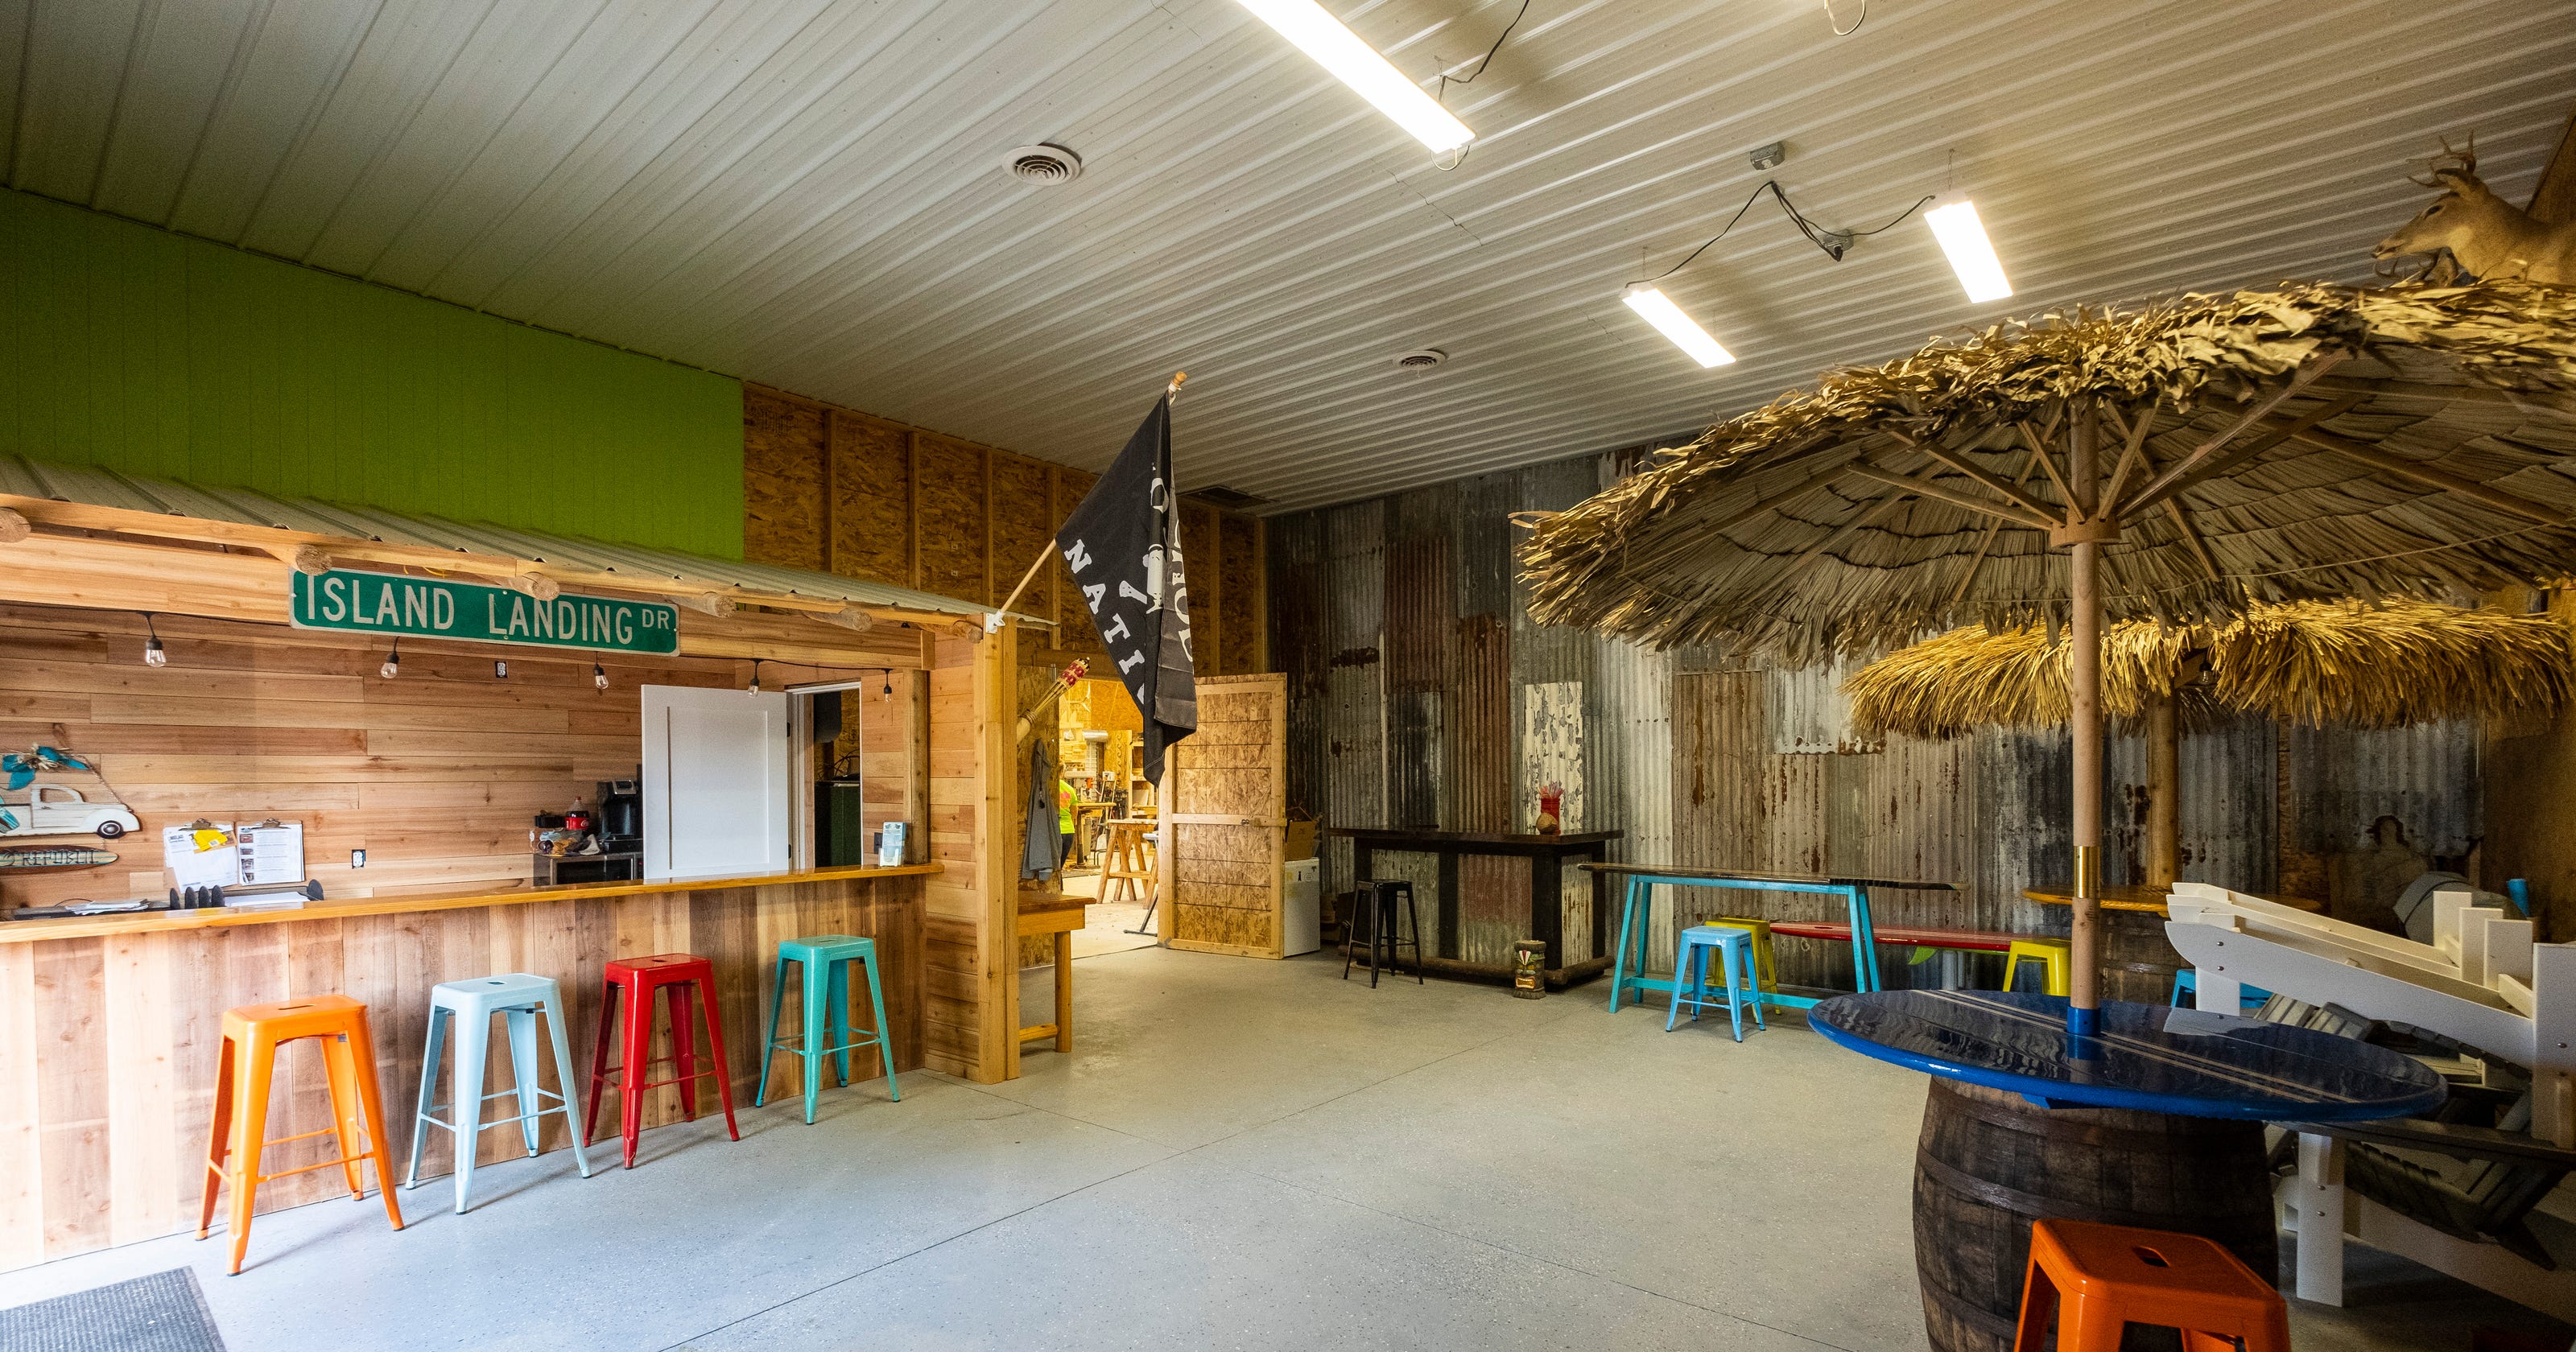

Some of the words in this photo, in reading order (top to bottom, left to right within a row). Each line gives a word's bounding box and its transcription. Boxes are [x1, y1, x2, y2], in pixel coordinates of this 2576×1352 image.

[307, 574, 455, 631] ISLAND
[488, 592, 634, 645] LANDING
[642, 608, 671, 631] DR
[1063, 538, 1146, 706] NATI
